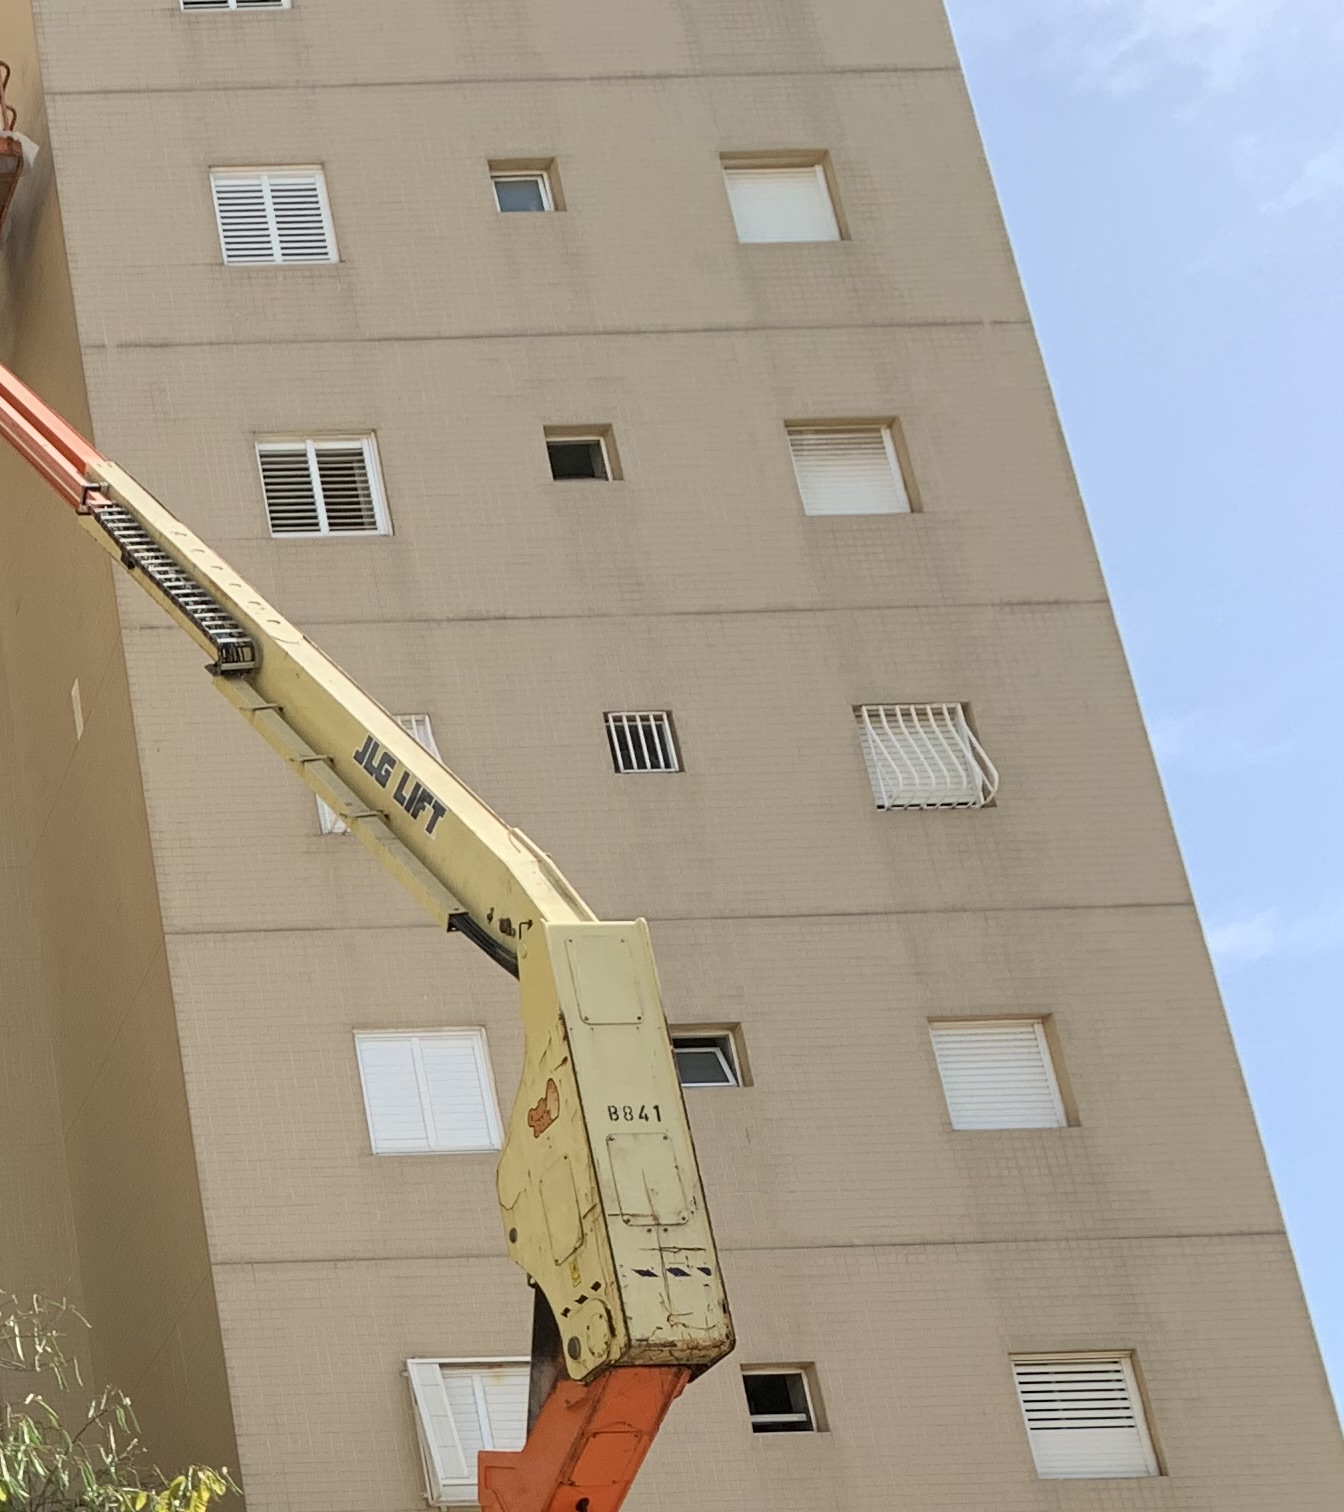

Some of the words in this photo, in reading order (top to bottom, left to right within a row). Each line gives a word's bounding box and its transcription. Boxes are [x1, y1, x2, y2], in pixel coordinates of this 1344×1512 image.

[353, 734, 398, 789] JLG
[393, 769, 447, 835] LIFT
[607, 1104, 662, 1123] B841
